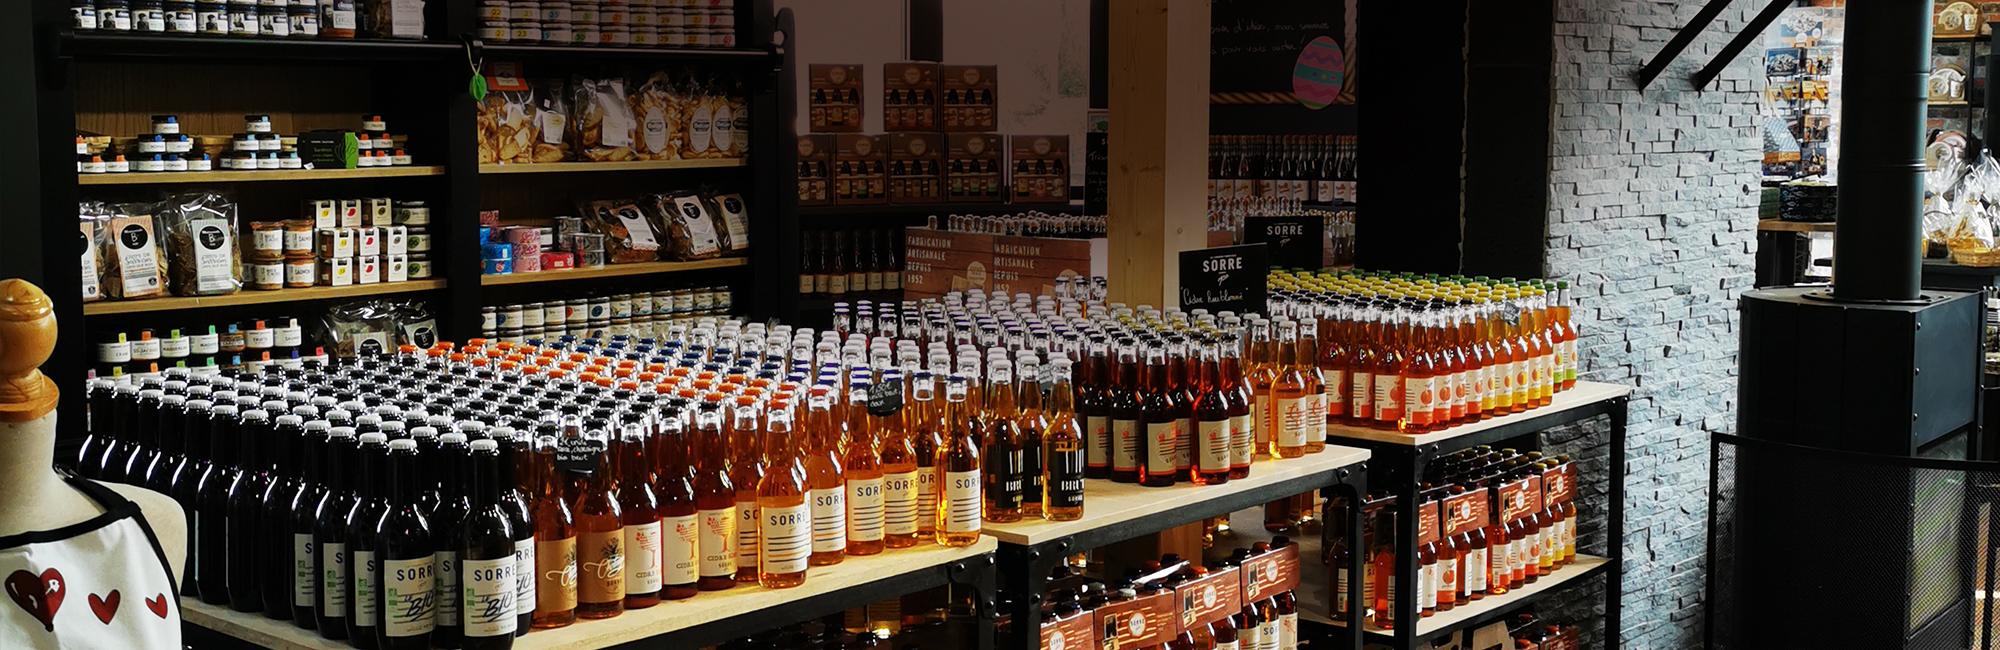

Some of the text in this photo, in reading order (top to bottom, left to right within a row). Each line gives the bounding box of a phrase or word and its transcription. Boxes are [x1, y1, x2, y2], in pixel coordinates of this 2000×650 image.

[1266, 224, 1304, 236] SORRE
[907, 235, 951, 249] FABRICATION
[907, 248, 946, 262] ARTISANALE
[907, 262, 932, 273] DEPUIS
[1202, 257, 1243, 273] SORRE
[920, 474, 936, 485] OR
[743, 509, 758, 521] SO
[396, 565, 433, 581] SORR
